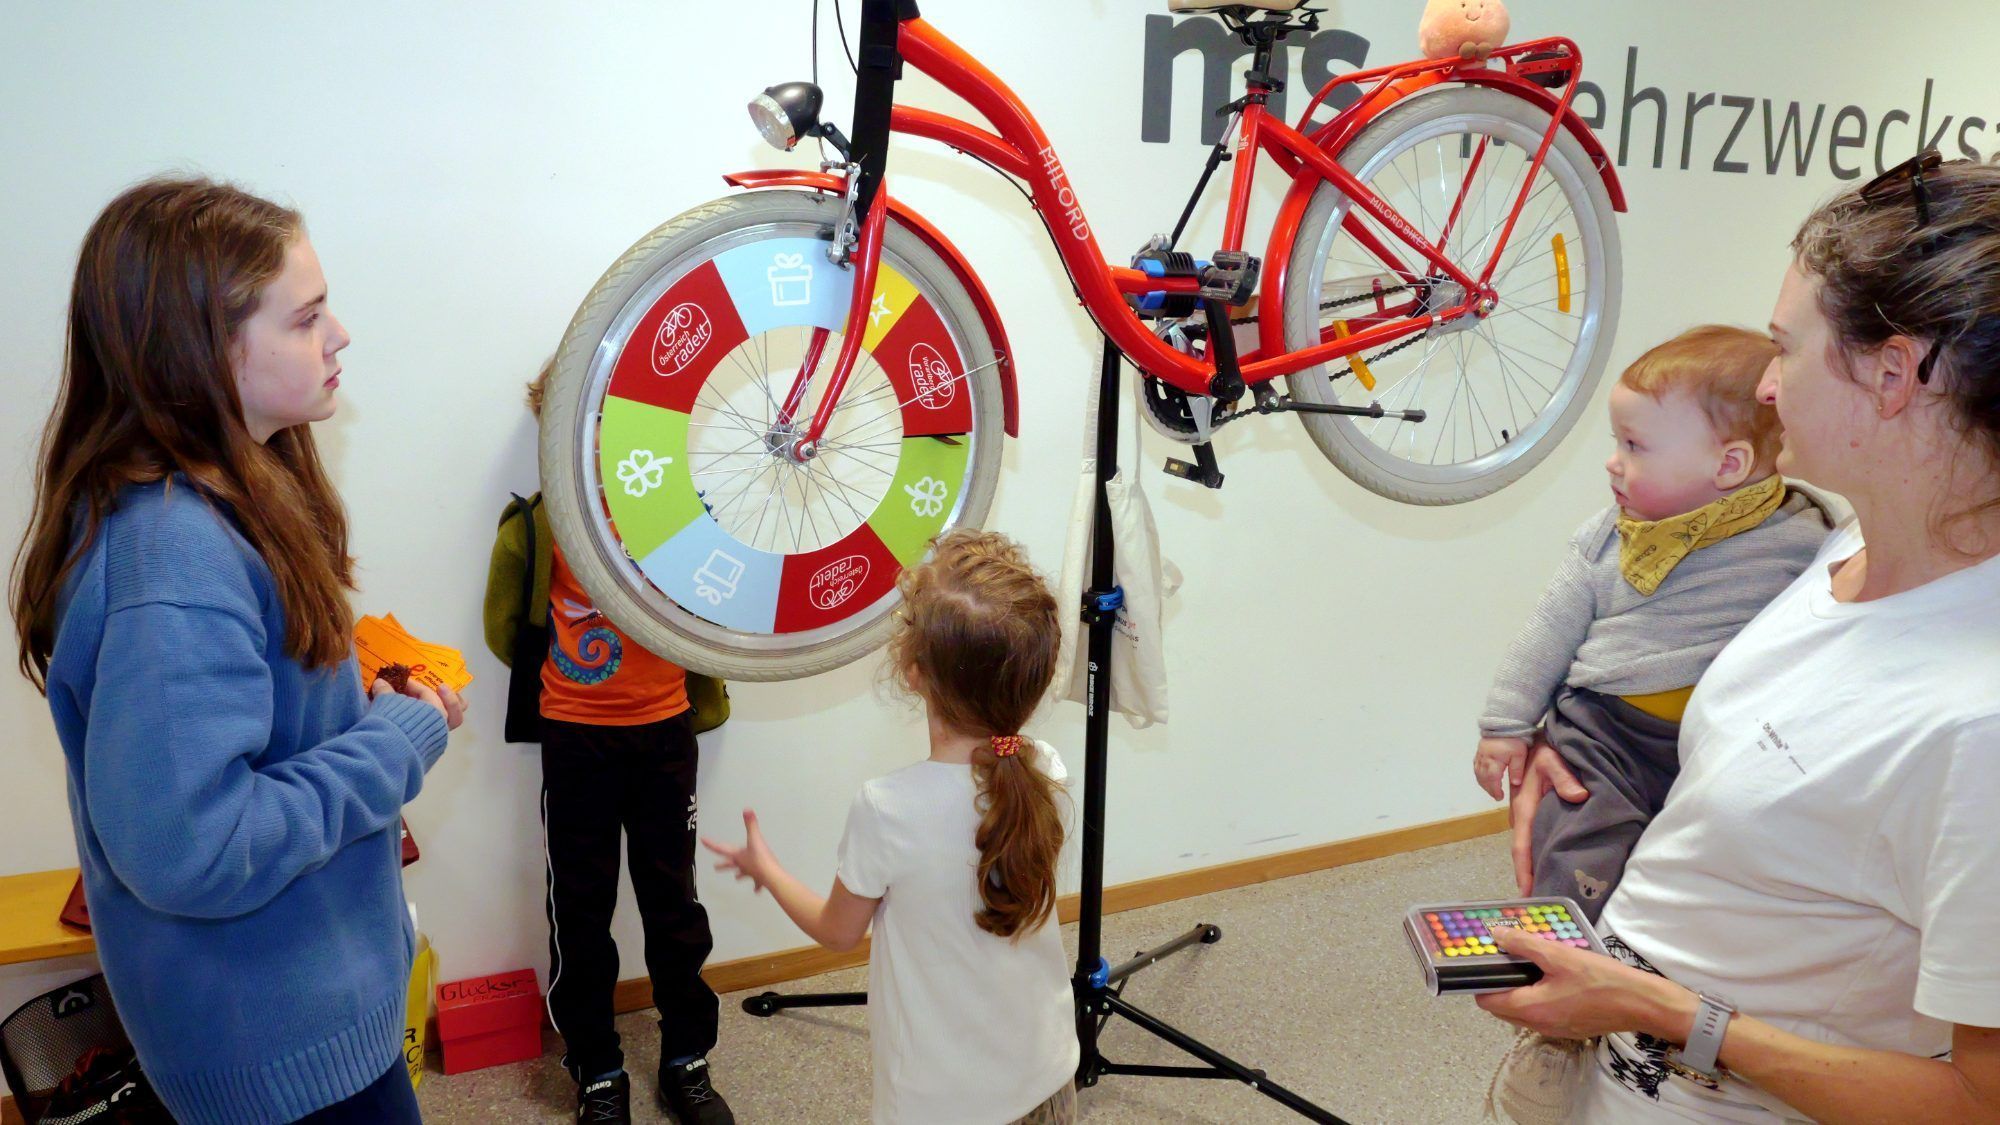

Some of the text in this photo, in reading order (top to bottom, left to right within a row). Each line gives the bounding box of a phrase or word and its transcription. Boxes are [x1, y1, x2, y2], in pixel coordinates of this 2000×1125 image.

[1459, 46, 2000, 181] ehrzwecks
[1038, 146, 1090, 241] MILORD
[1369, 196, 1428, 249] MILORD BIKES
[674, 322, 709, 370] radelt
[814, 557, 852, 588] radelt
